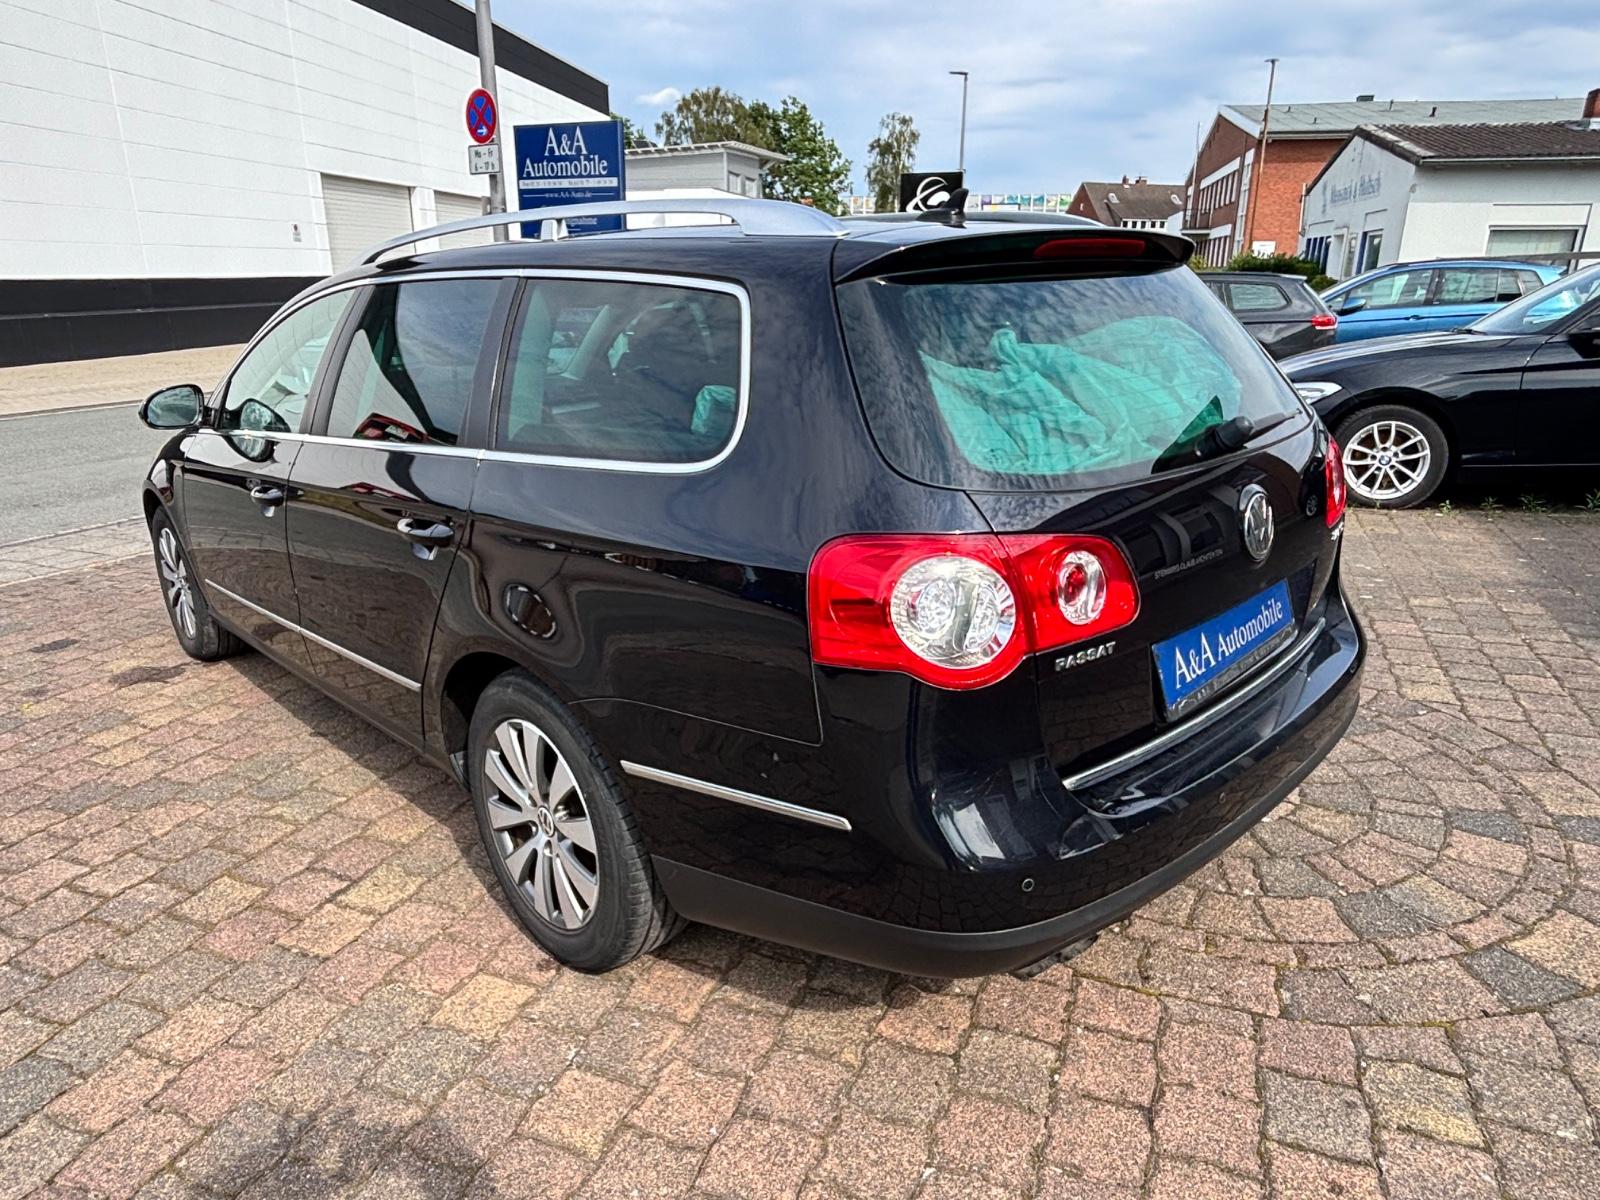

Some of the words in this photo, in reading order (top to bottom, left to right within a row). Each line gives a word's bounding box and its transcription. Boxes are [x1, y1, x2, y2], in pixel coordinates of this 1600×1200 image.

[544, 125, 588, 156] A&A
[522, 154, 608, 178] Automobile
[1054, 641, 1116, 671] PASSAT
[1175, 631, 1217, 689] A&A
[1218, 597, 1283, 661] Automobile
